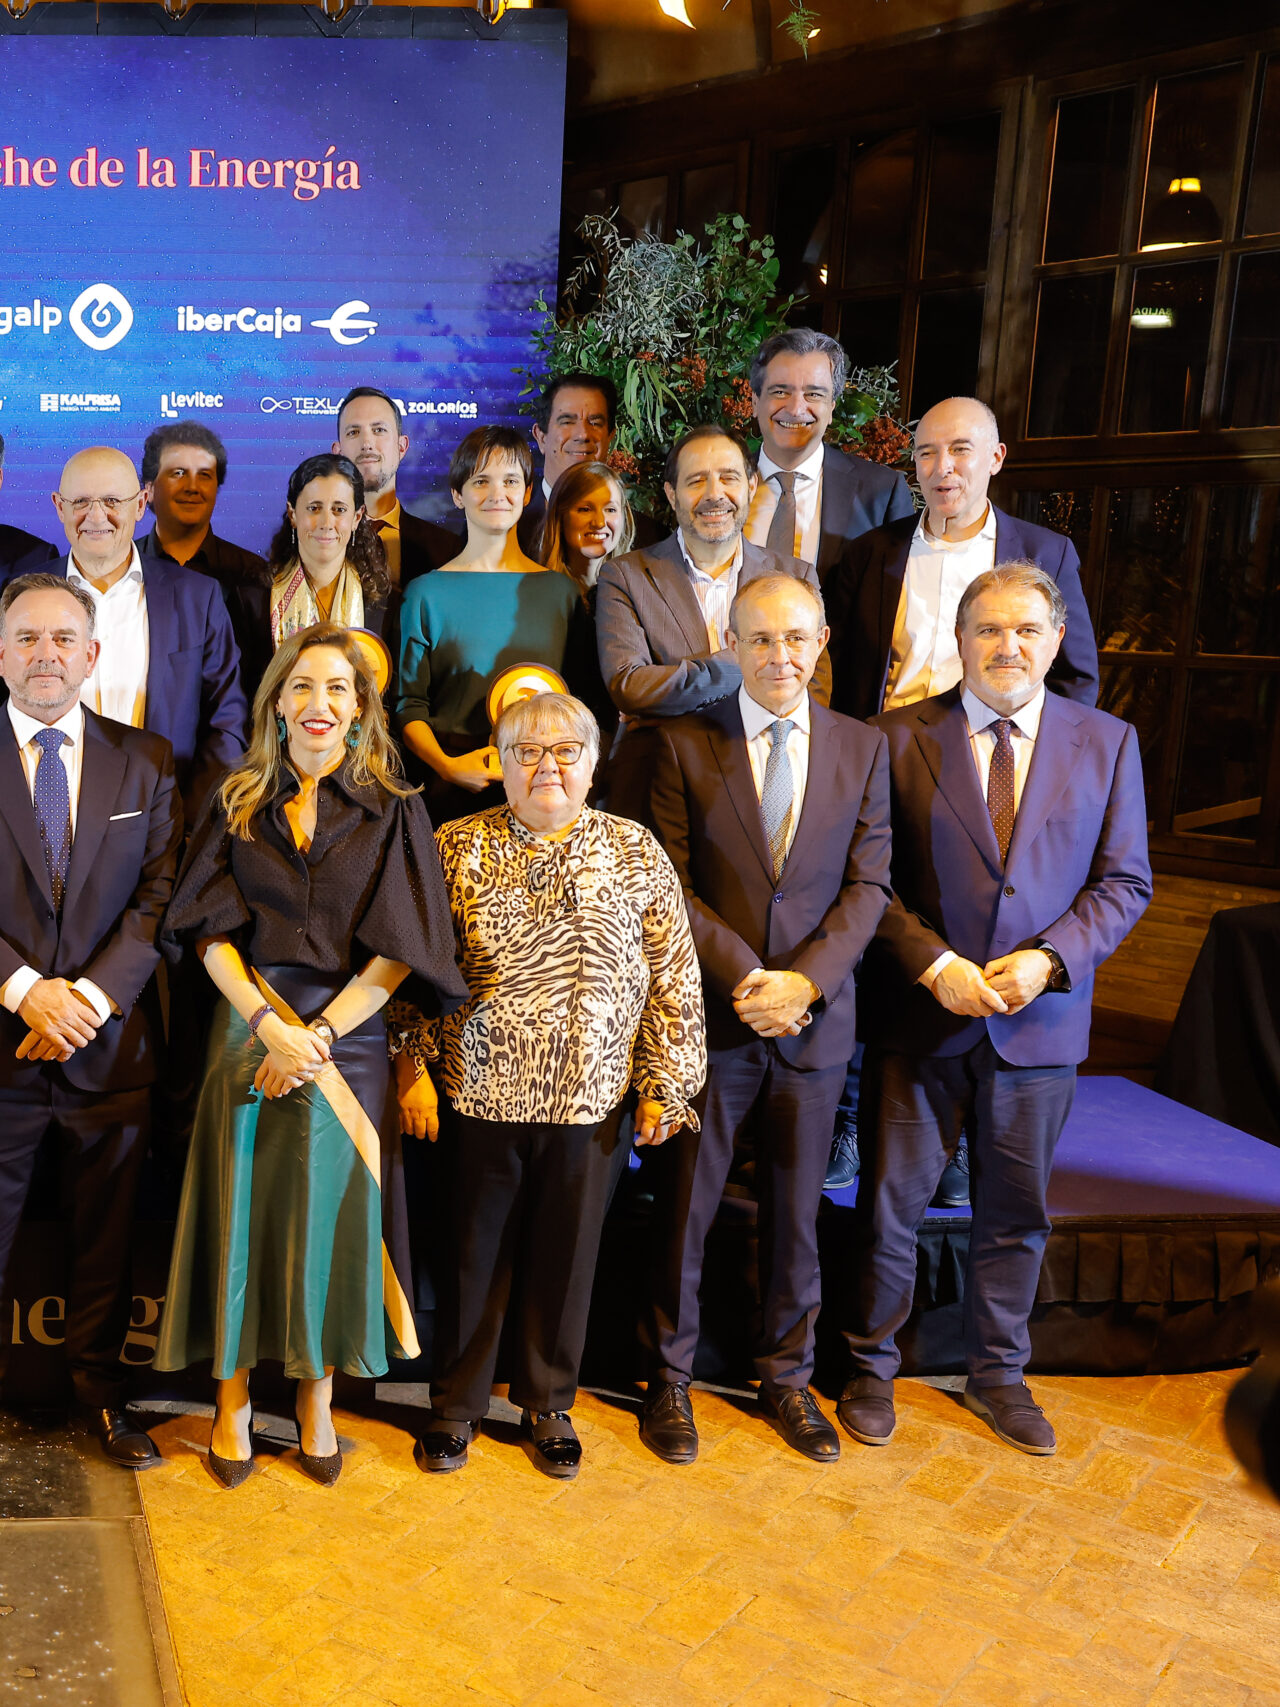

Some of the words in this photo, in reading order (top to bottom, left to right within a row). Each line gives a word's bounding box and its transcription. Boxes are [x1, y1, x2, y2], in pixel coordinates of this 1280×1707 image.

[68, 148, 124, 187] de
[137, 148, 177, 187] la
[189, 145, 361, 201] Energía
[177, 306, 302, 339] iberCaja
[407, 400, 478, 414] ZOILORÍOS
